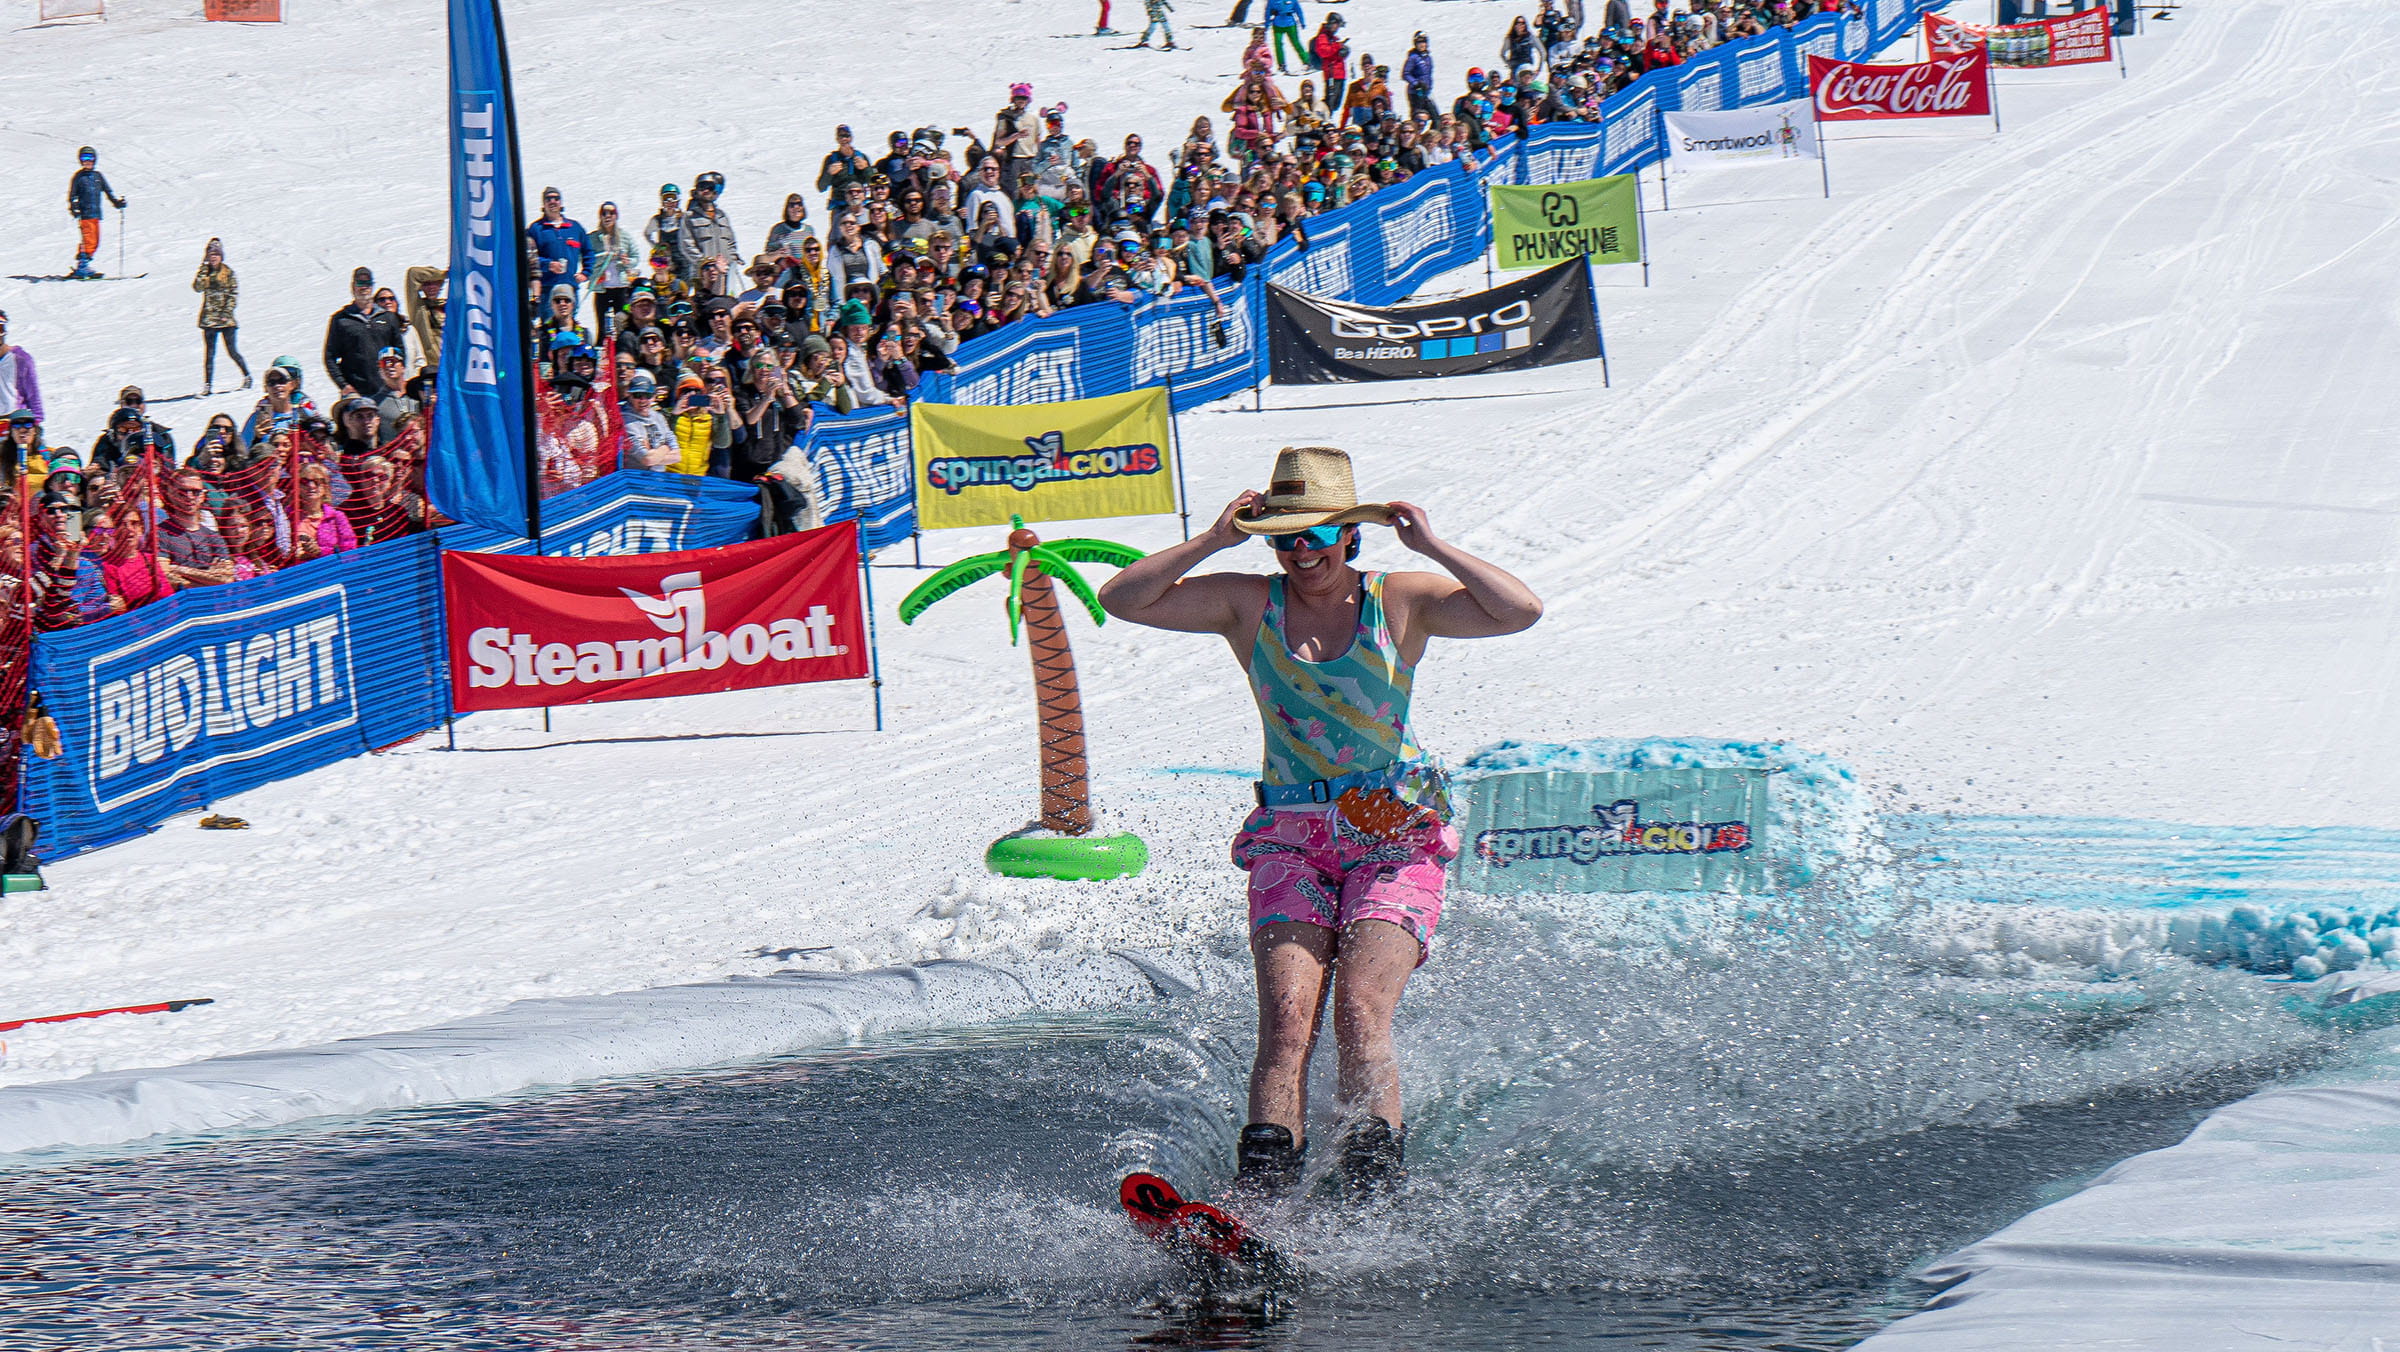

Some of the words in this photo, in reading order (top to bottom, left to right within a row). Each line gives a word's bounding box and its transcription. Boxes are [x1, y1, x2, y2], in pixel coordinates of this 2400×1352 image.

[1817, 55, 1979, 115] Coca-Cola
[1683, 130, 1772, 153] Smartwool
[1512, 227, 1606, 262] PHUNKSHUN
[1331, 300, 1531, 338] GoPro
[1334, 347, 1353, 360] Be
[1365, 346, 1417, 359] HERO.
[467, 570, 839, 689] Steamboat
[100, 653, 202, 779] BUD
[203, 613, 340, 738] LIGHT
